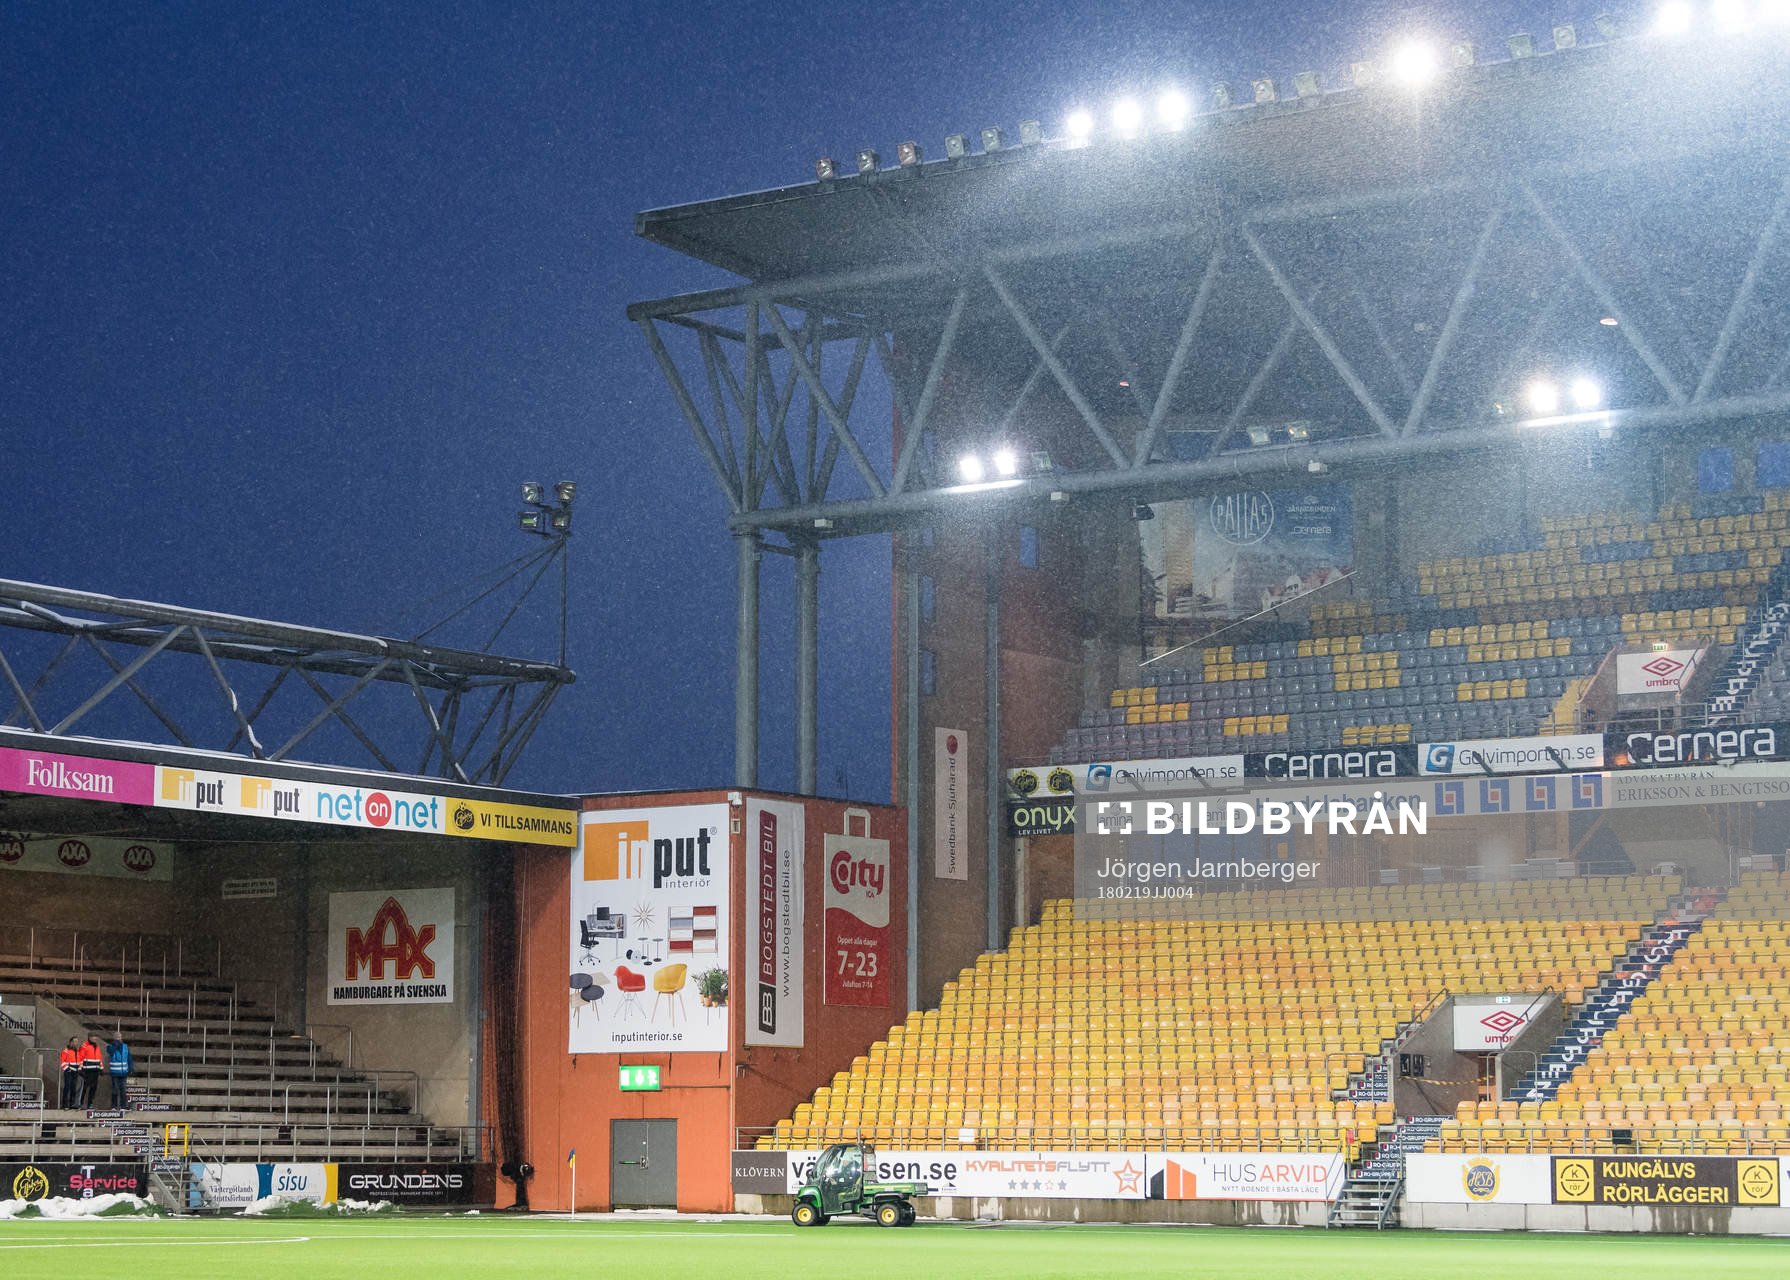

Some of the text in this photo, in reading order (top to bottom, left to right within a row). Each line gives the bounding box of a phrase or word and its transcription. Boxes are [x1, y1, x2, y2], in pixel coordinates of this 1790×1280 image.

[1645, 677, 1680, 687] umbro
[27, 758, 114, 795] Folksam
[1617, 786, 1690, 801] ERIKSSON
[1694, 785, 1705, 797] &
[480, 812, 491, 827] VI
[494, 814, 573, 835] TILLSAMMANS
[1013, 805, 1078, 831] onyx
[61, 842, 88, 861] AXA
[948, 815, 956, 874] Swedbank
[126, 848, 153, 866] AXA
[830, 850, 885, 896] City
[665, 878, 711, 889] interiör
[762, 819, 775, 977] BOGSTEDT BIL
[782, 849, 792, 999] www.bogstedtbil.se
[346, 896, 436, 981] MAX
[837, 950, 878, 977] 7-23
[333, 982, 447, 999] HAMBURGARE PÅ SVENSKA
[611, 1031, 683, 1044] inputinterior.se
[1484, 1034, 1514, 1043] umbr
[735, 1164, 785, 1178] KLÖVERN
[1571, 1169, 1579, 1178] K
[1602, 1159, 1696, 1179] KUNGÄLVS
[1753, 1171, 1761, 1180] K
[70, 1174, 138, 1189] Service
[1603, 1183, 1729, 1203] RÖRLÄGGERI
